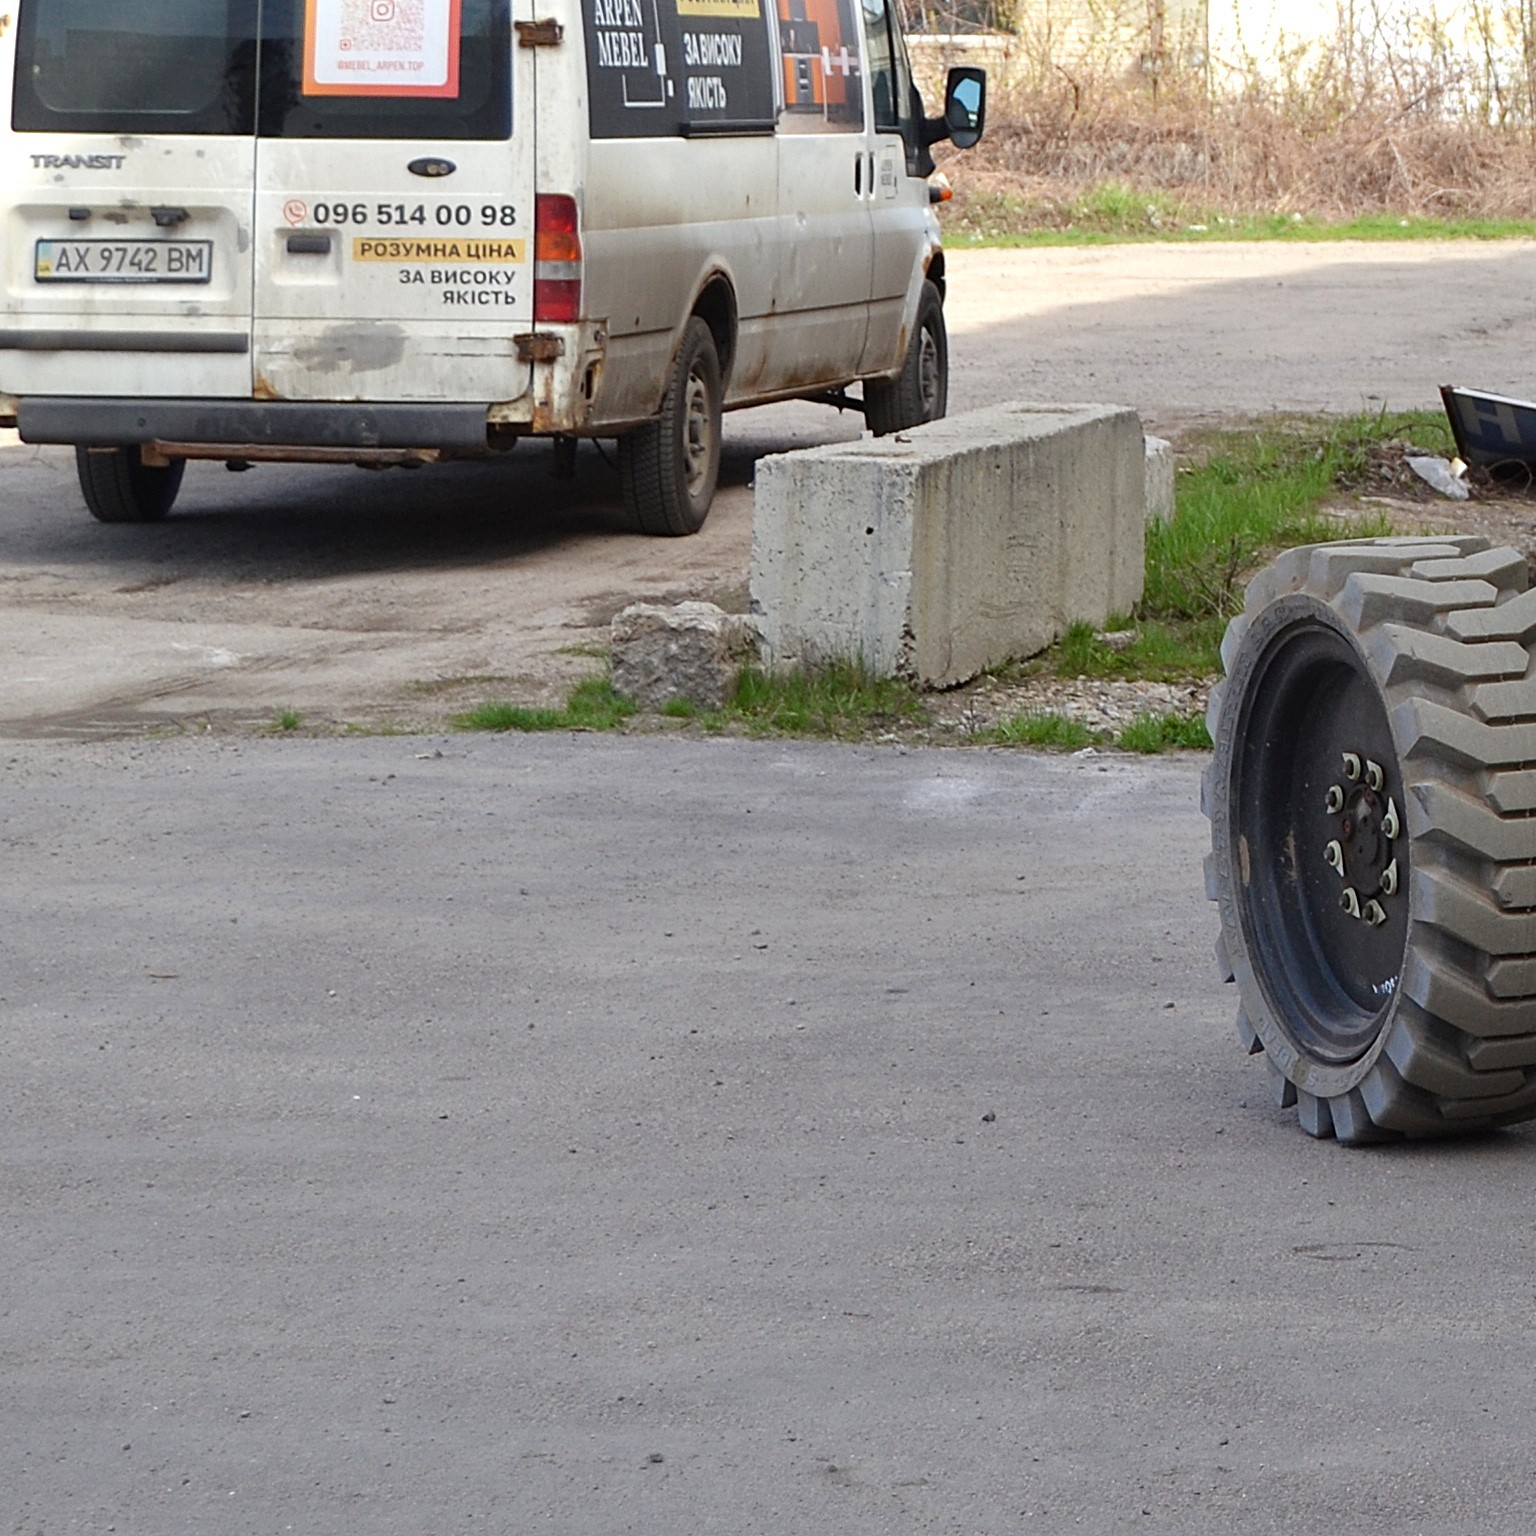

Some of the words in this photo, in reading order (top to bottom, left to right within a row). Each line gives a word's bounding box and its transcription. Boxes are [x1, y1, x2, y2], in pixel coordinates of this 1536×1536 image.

[598, 32, 648, 67] MEBEL
[685, 33, 700, 65] ЗА
[701, 33, 742, 66] ВИСОКУ
[689, 78, 726, 108] ЯКІСТЬ
[30, 154, 126, 170] TRANSIT
[313, 204, 367, 226] 096
[377, 204, 426, 226] 514
[437, 204, 471, 227] 00
[481, 204, 517, 227] 98
[55, 247, 90, 272] AX
[99, 247, 157, 272] 9742
[168, 247, 203, 272] BM
[360, 242, 460, 259] РОЗУМНА
[468, 242, 517, 260] ЦІНА
[398, 270, 424, 285] ЗА
[430, 270, 515, 285] ВИСОКУ
[443, 290, 516, 305] ЯКІСТЬ
